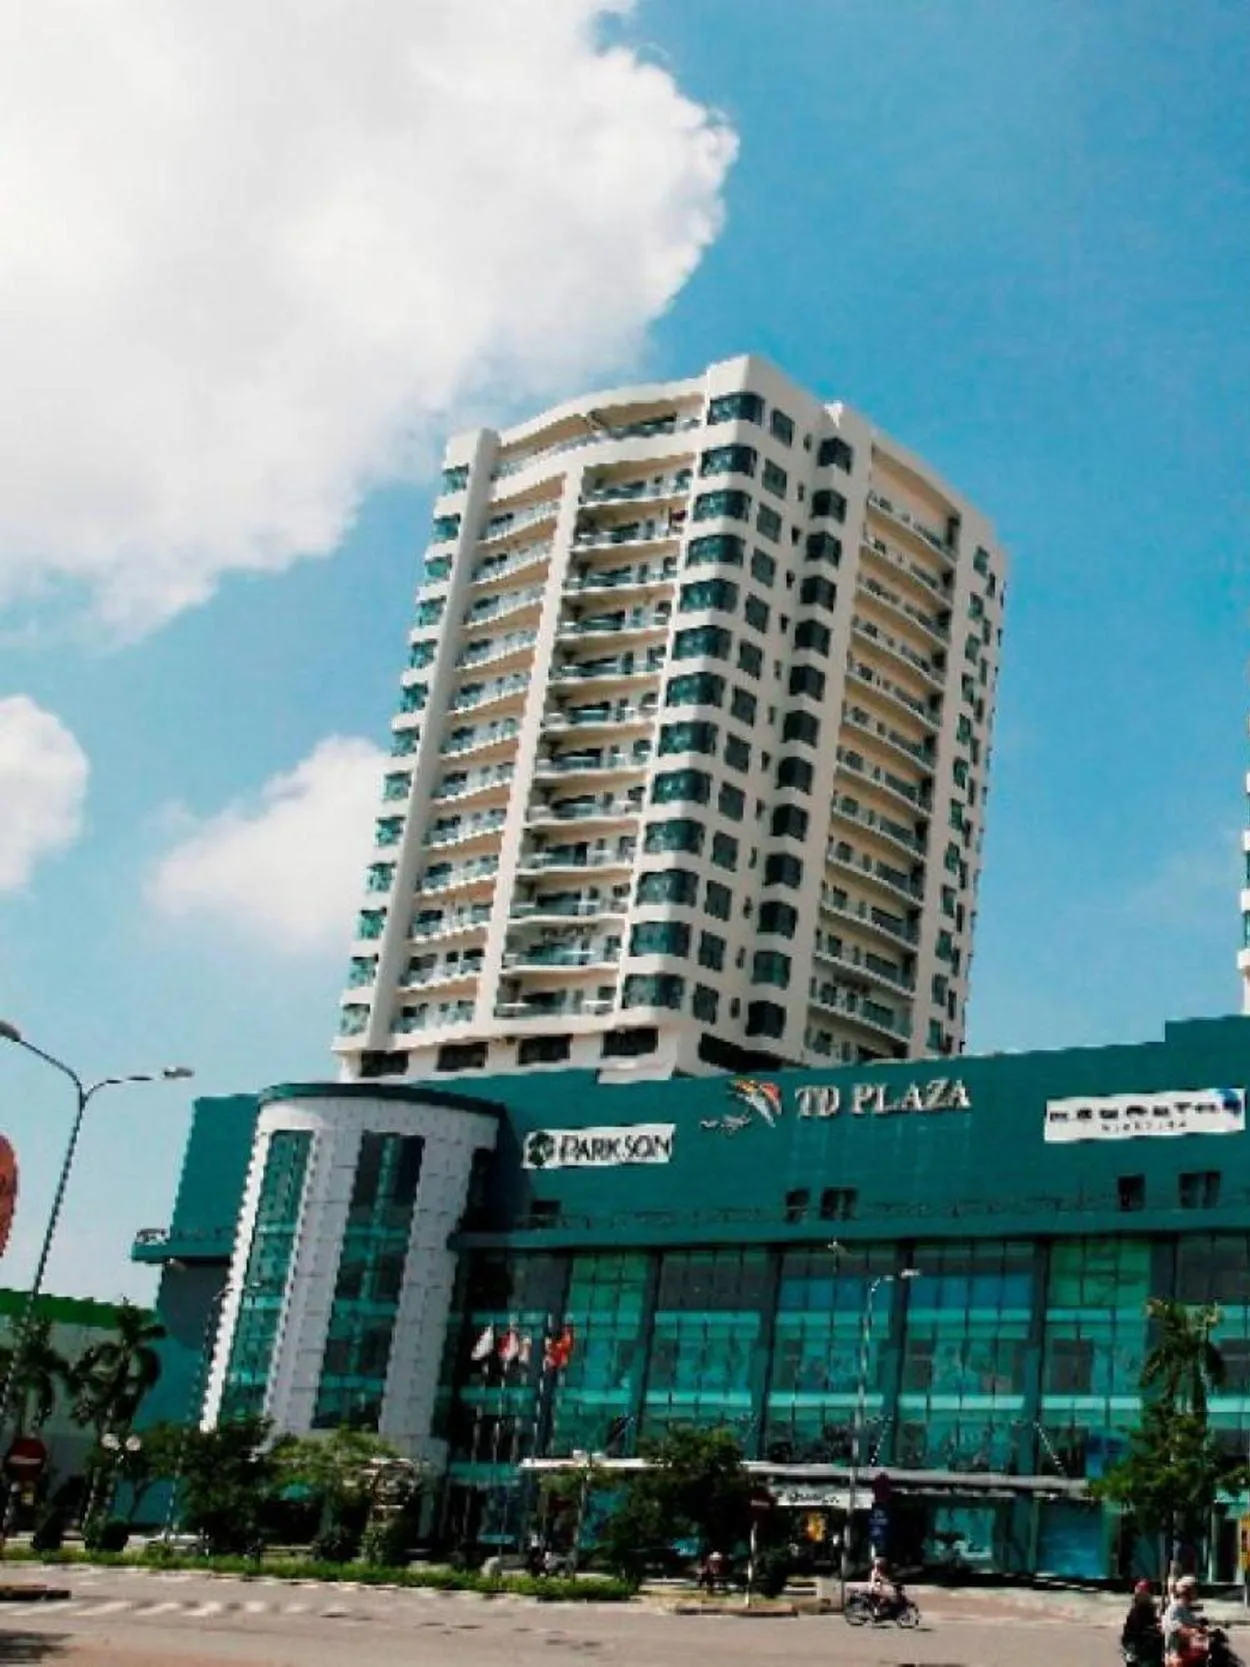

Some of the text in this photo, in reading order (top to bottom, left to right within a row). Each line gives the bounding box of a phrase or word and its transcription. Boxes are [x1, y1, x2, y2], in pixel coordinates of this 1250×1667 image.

[794, 1076, 972, 1118] TD PLAZA
[559, 1133, 671, 1162] PARKSON
